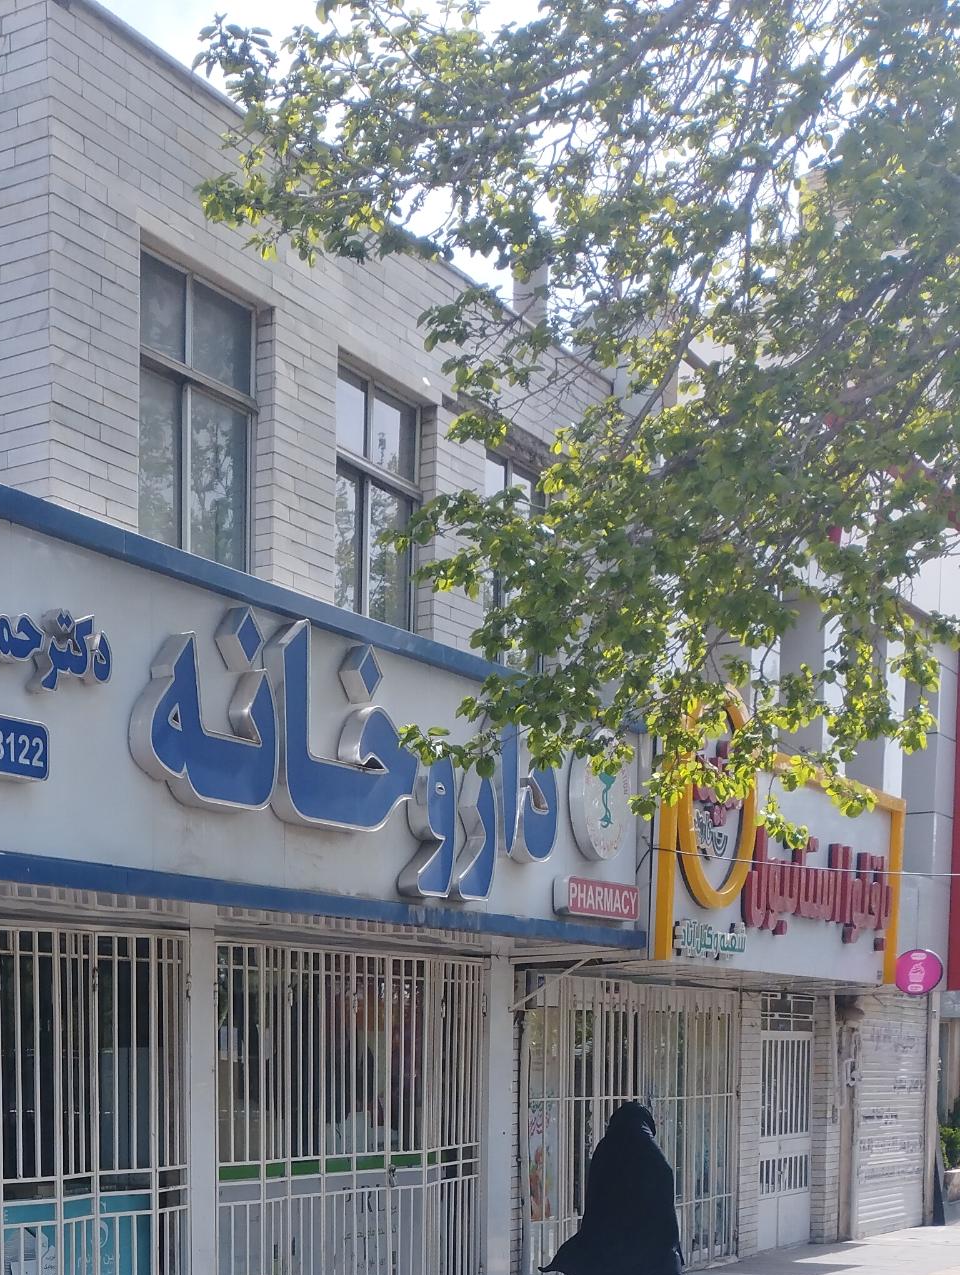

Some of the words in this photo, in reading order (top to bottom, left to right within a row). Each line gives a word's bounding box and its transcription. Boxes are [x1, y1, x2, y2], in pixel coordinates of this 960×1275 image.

[38, 608, 113, 692] دکتر
[140, 607, 558, 901] داروخانه
[569, 882, 638, 916] PHARMACY
